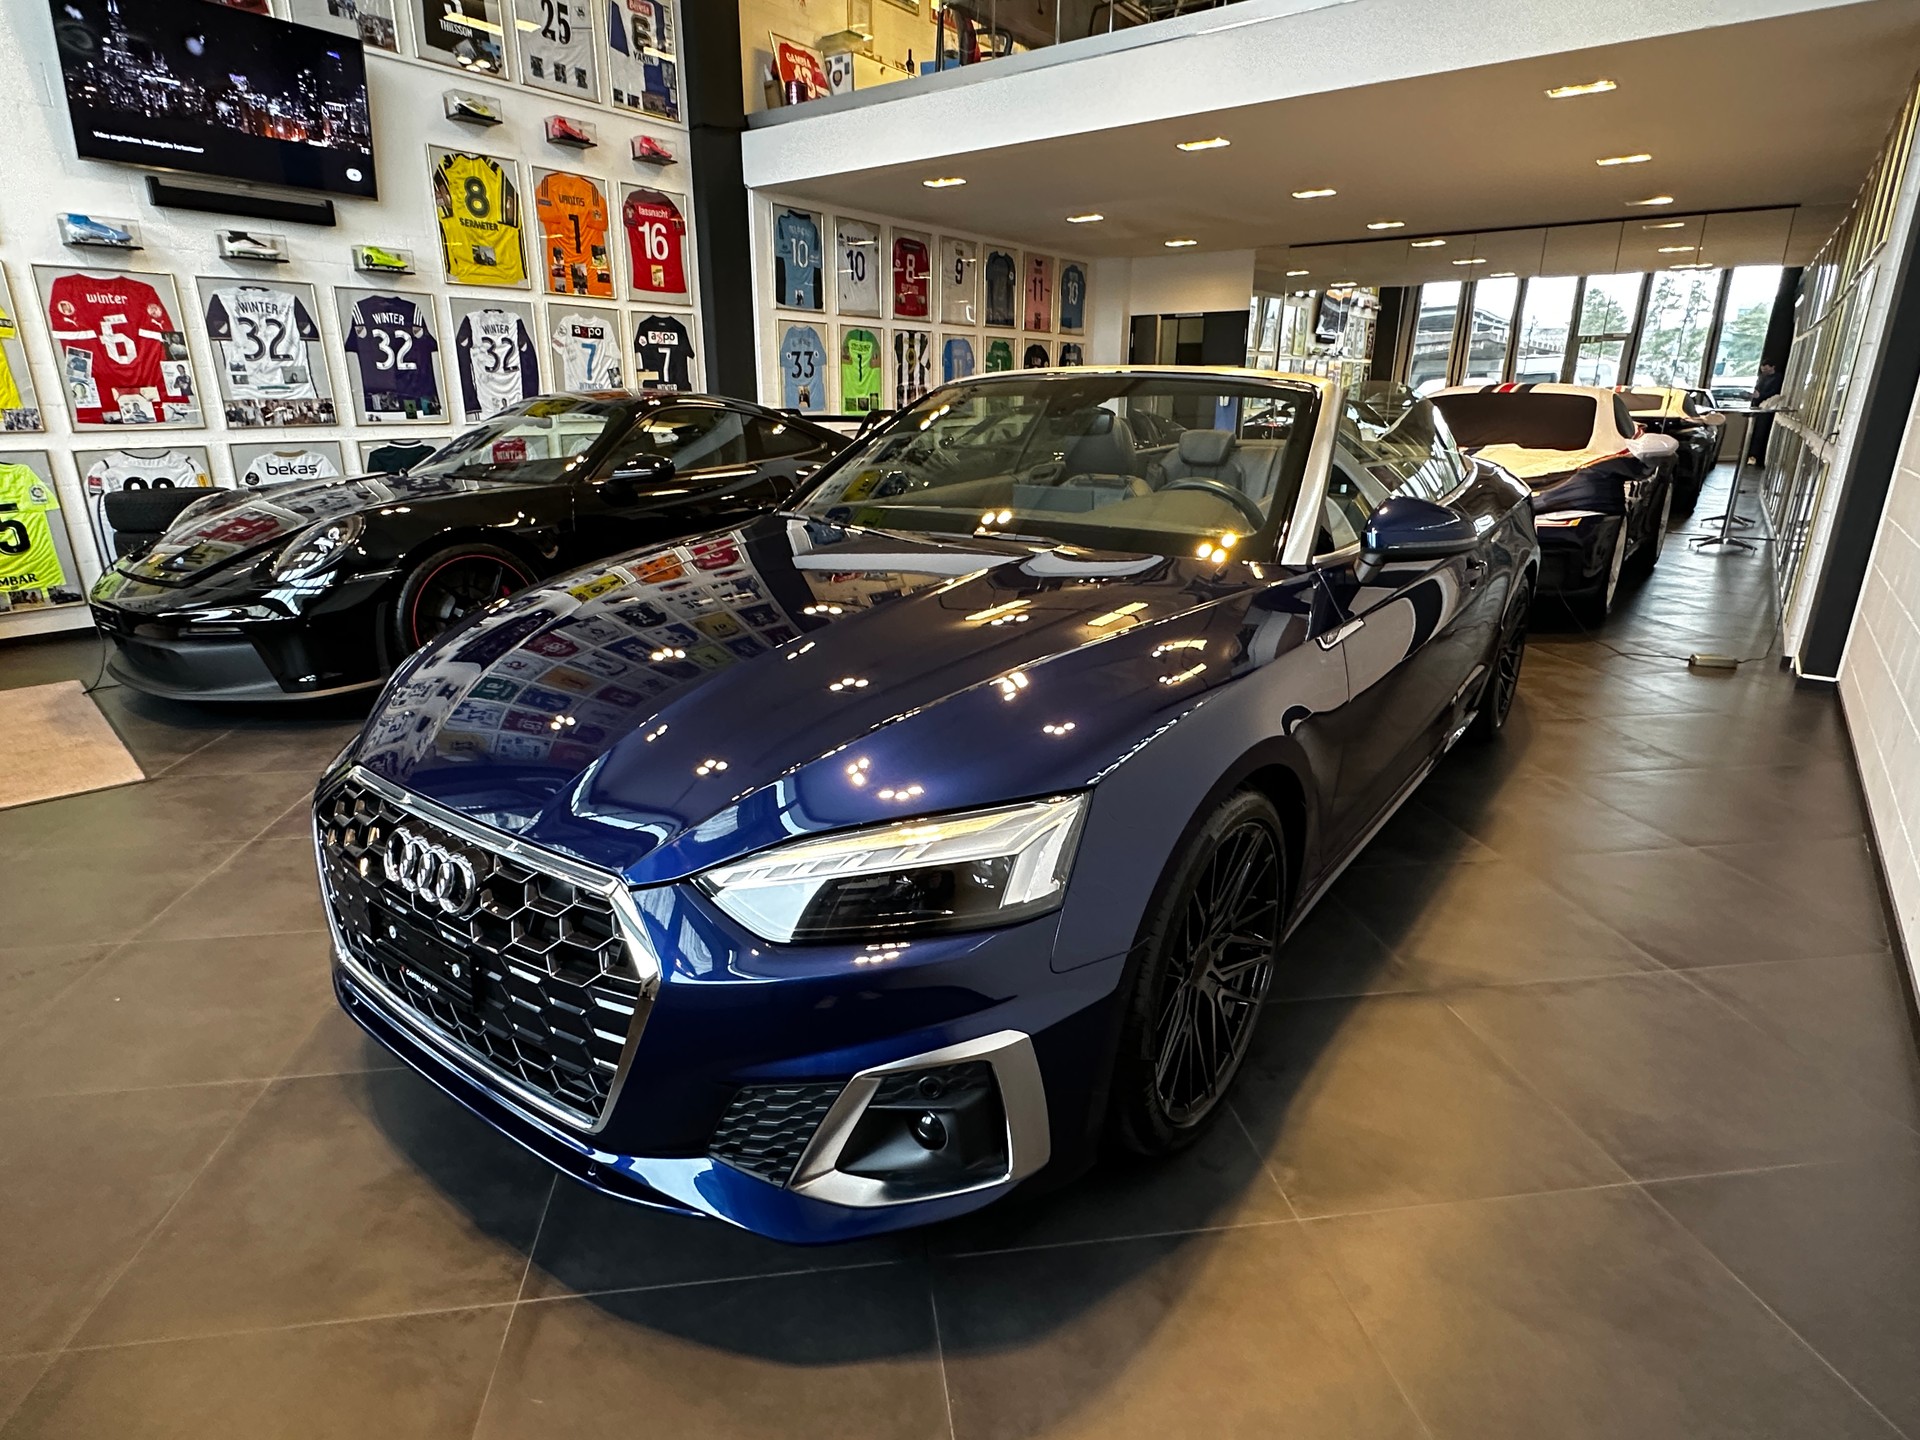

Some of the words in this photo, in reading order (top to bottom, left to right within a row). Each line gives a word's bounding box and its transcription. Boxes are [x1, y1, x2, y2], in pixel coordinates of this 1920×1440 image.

[541, 0, 571, 45] 25
[464, 175, 490, 218] 8
[568, 214, 581, 254] 1
[638, 221, 669, 261] 16
[791, 238, 809, 268] 10
[846, 249, 866, 282] 10
[905, 253, 916, 284] 8
[955, 258, 964, 285] 9
[86, 292, 127, 305] winter
[238, 301, 279, 315] WINTER
[1067, 280, 1079, 305] 10
[371, 312, 405, 326] WINTER
[481, 323, 511, 335] WINTER
[99, 314, 138, 365] 6
[237, 316, 295, 362] 32
[371, 328, 418, 371] 32
[481, 336, 520, 373] 32
[581, 343, 597, 381] 7
[658, 347, 671, 383] 7
[791, 351, 815, 379] 33
[265, 461, 318, 476] bekaş
